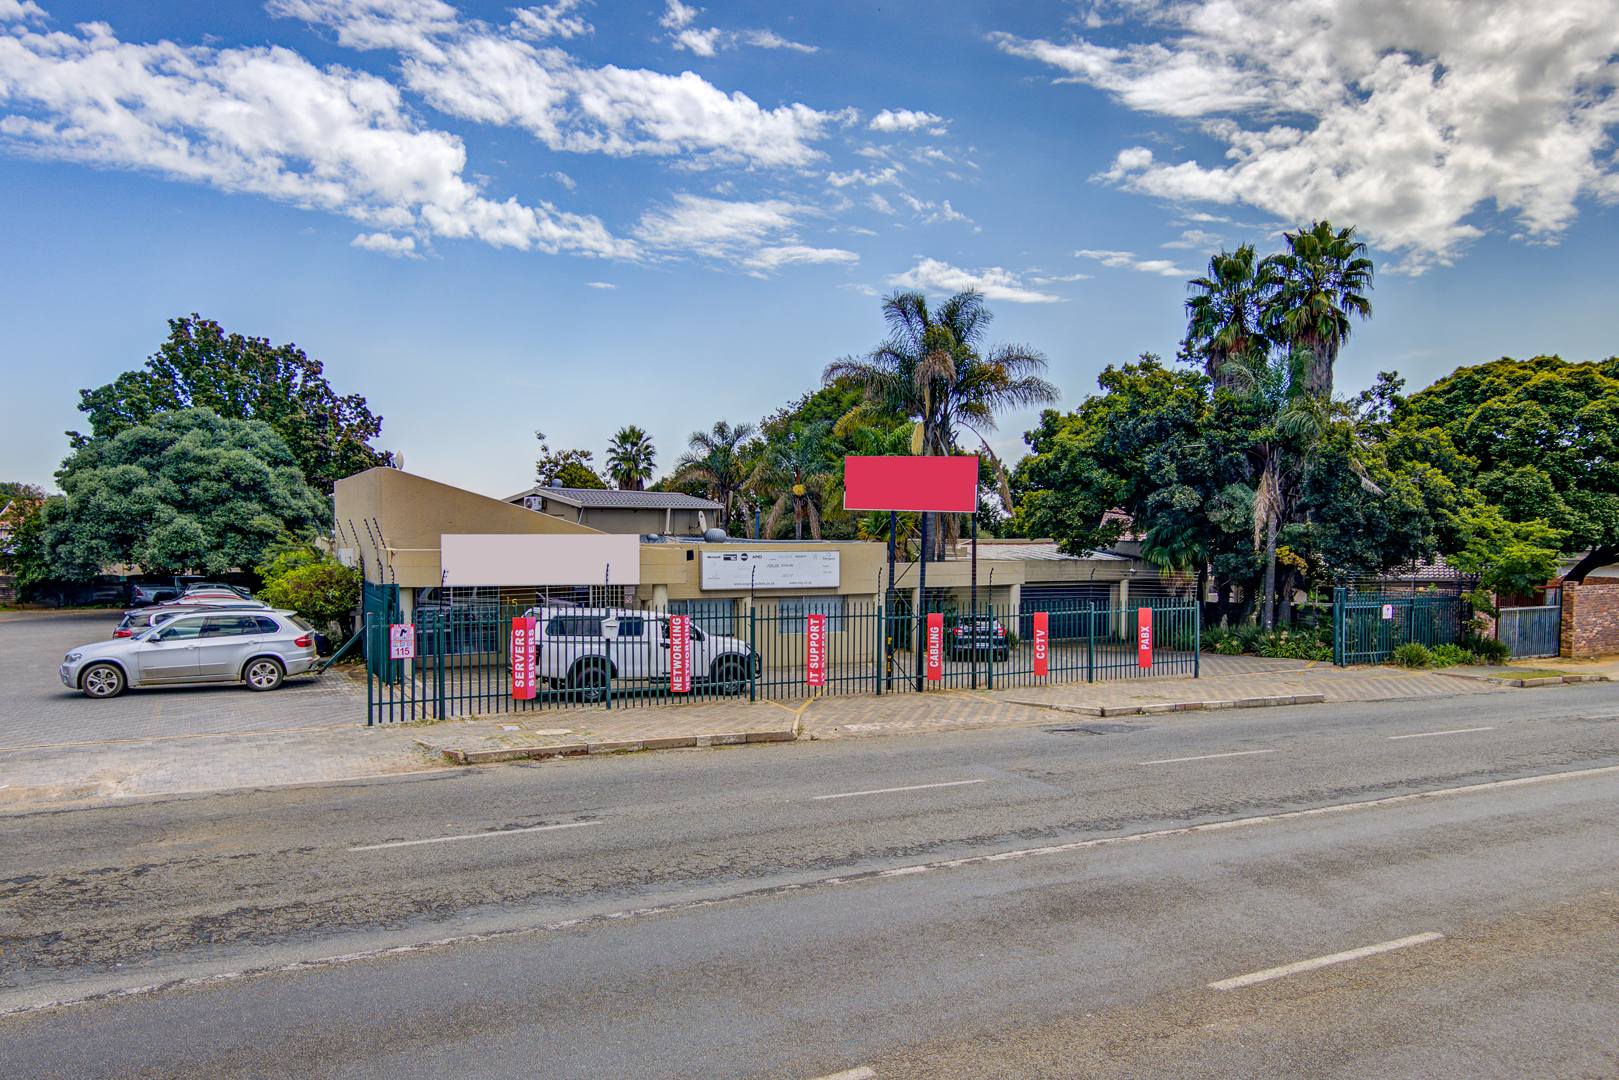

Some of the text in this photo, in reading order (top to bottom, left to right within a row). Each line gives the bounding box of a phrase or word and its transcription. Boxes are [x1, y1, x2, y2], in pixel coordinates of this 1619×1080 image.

[395, 647, 410, 656] 115
[514, 629, 525, 688] SERVERS
[672, 617, 682, 690] NETWORKING
[809, 618, 819, 683] IT SUPPORT
[930, 626, 939, 668] CABLING
[1036, 629, 1046, 660] CCTV
[1140, 626, 1150, 650] PABX
